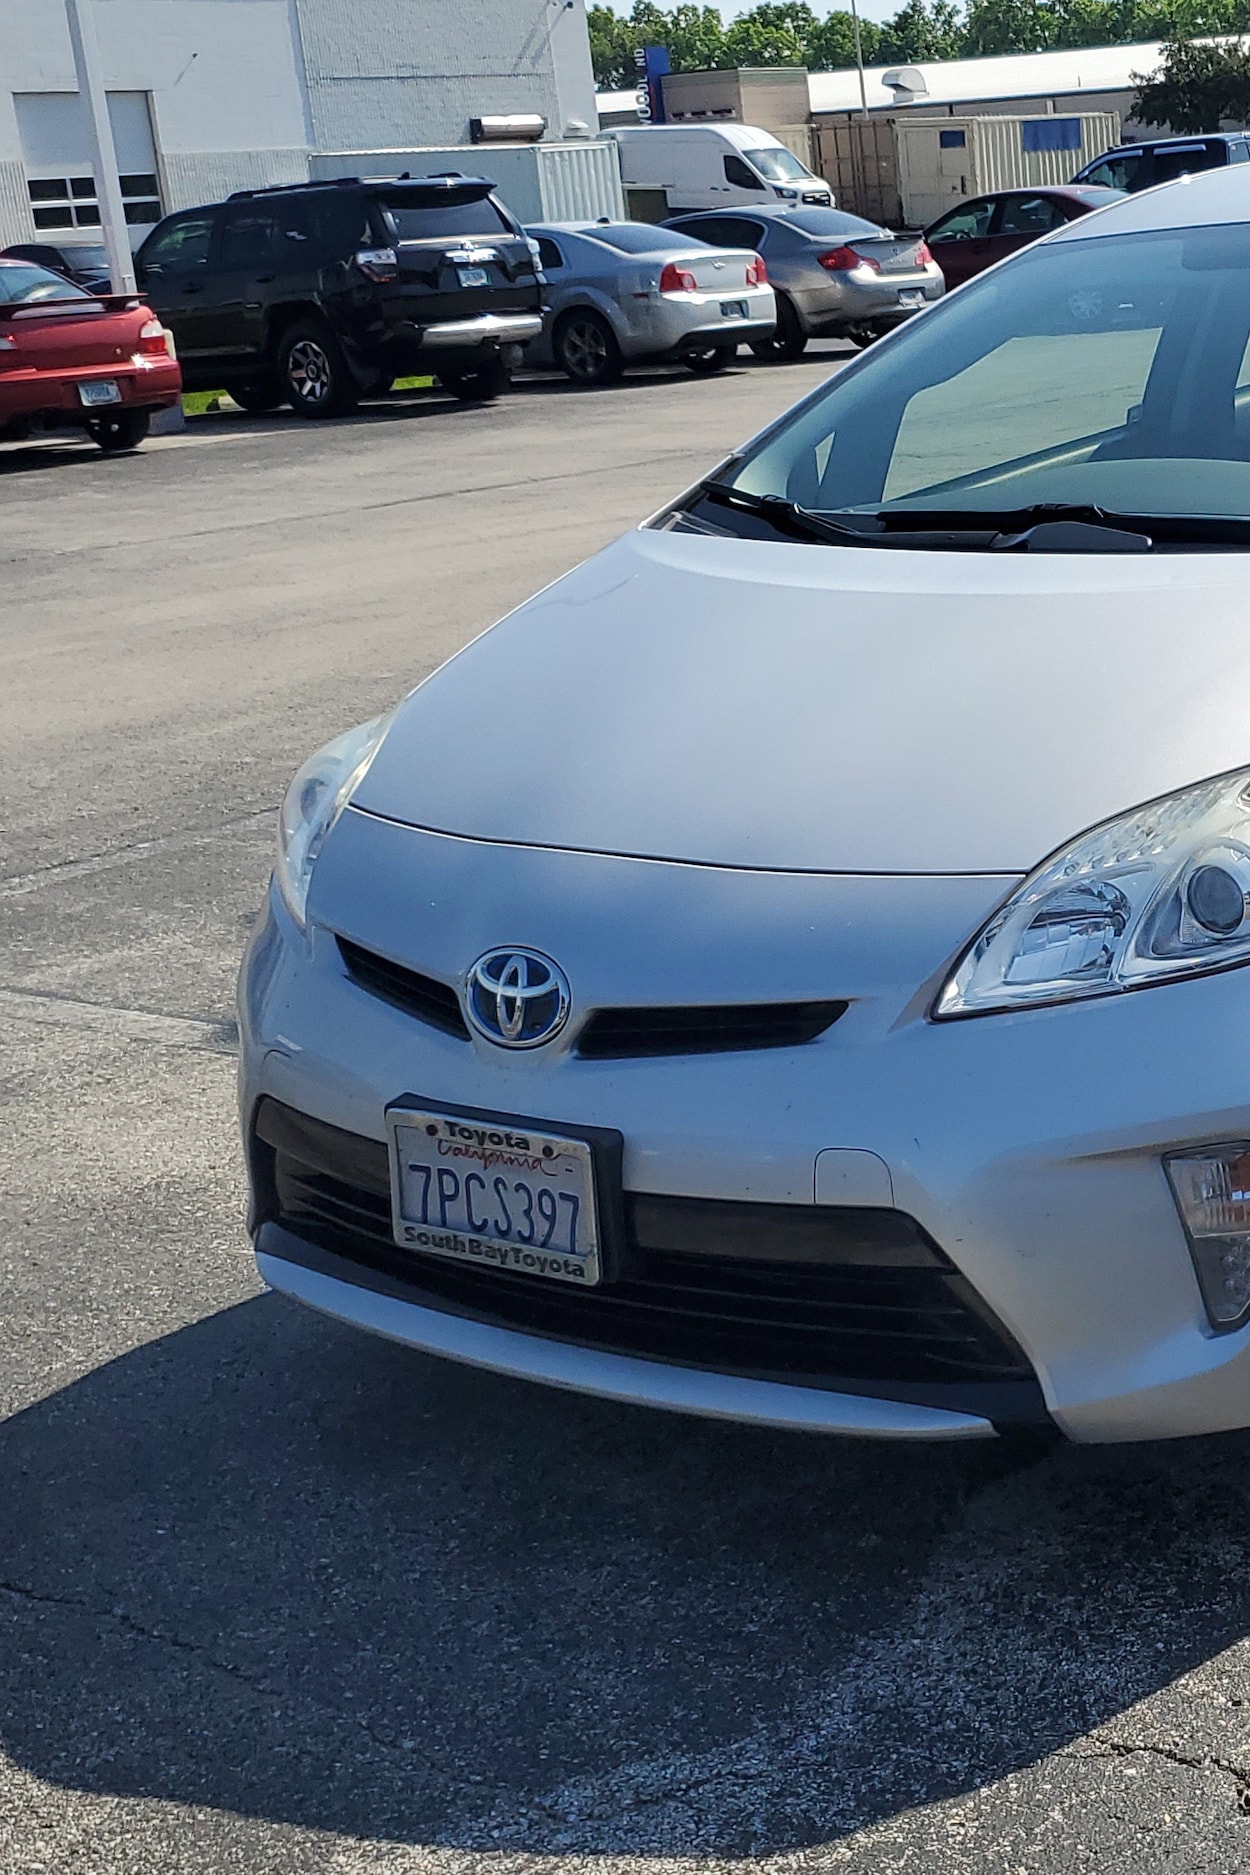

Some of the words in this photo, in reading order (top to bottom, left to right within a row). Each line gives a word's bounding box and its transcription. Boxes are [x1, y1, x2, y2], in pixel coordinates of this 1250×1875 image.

[444, 1120, 531, 1151] Toyota
[408, 1163, 580, 1255] 7PCS397
[510, 1246, 586, 1279] Toyota
